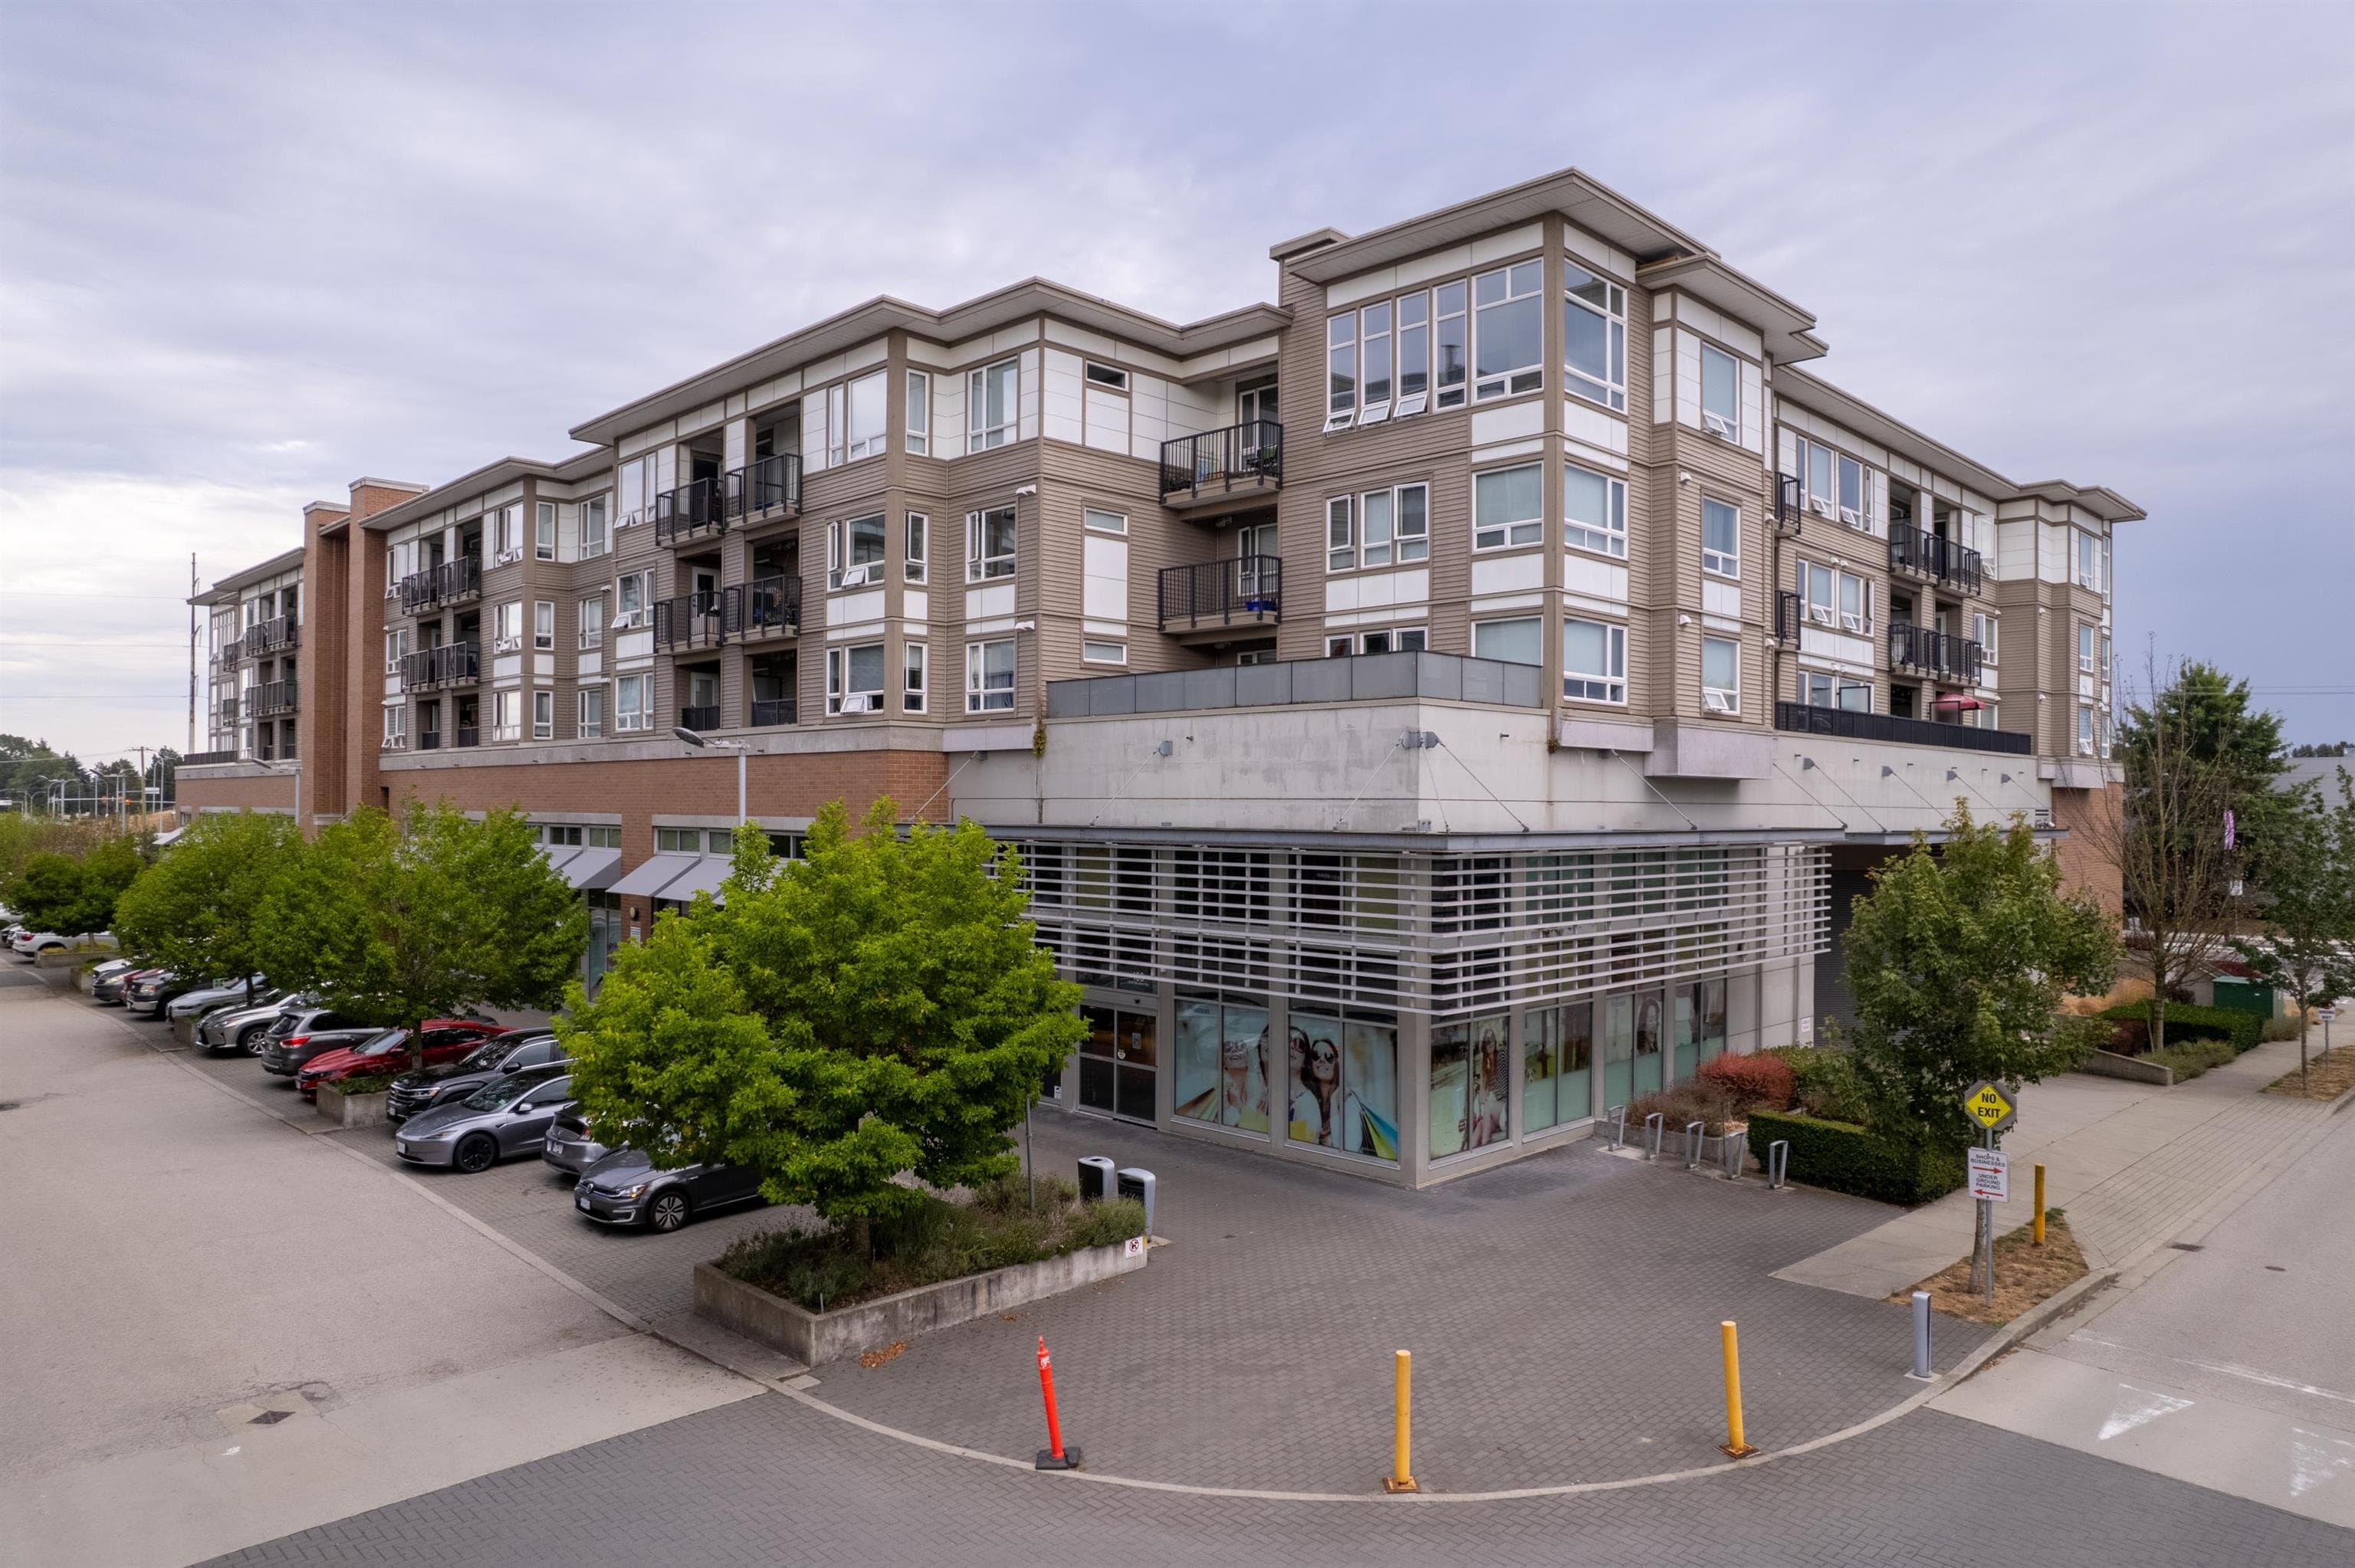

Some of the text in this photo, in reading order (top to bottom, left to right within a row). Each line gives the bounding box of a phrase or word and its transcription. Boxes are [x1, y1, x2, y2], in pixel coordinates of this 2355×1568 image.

[1982, 1093, 1996, 1104] NO
[1978, 1107, 2000, 1118] EXIT
[1970, 1158, 2005, 1167] BUSINESSES
